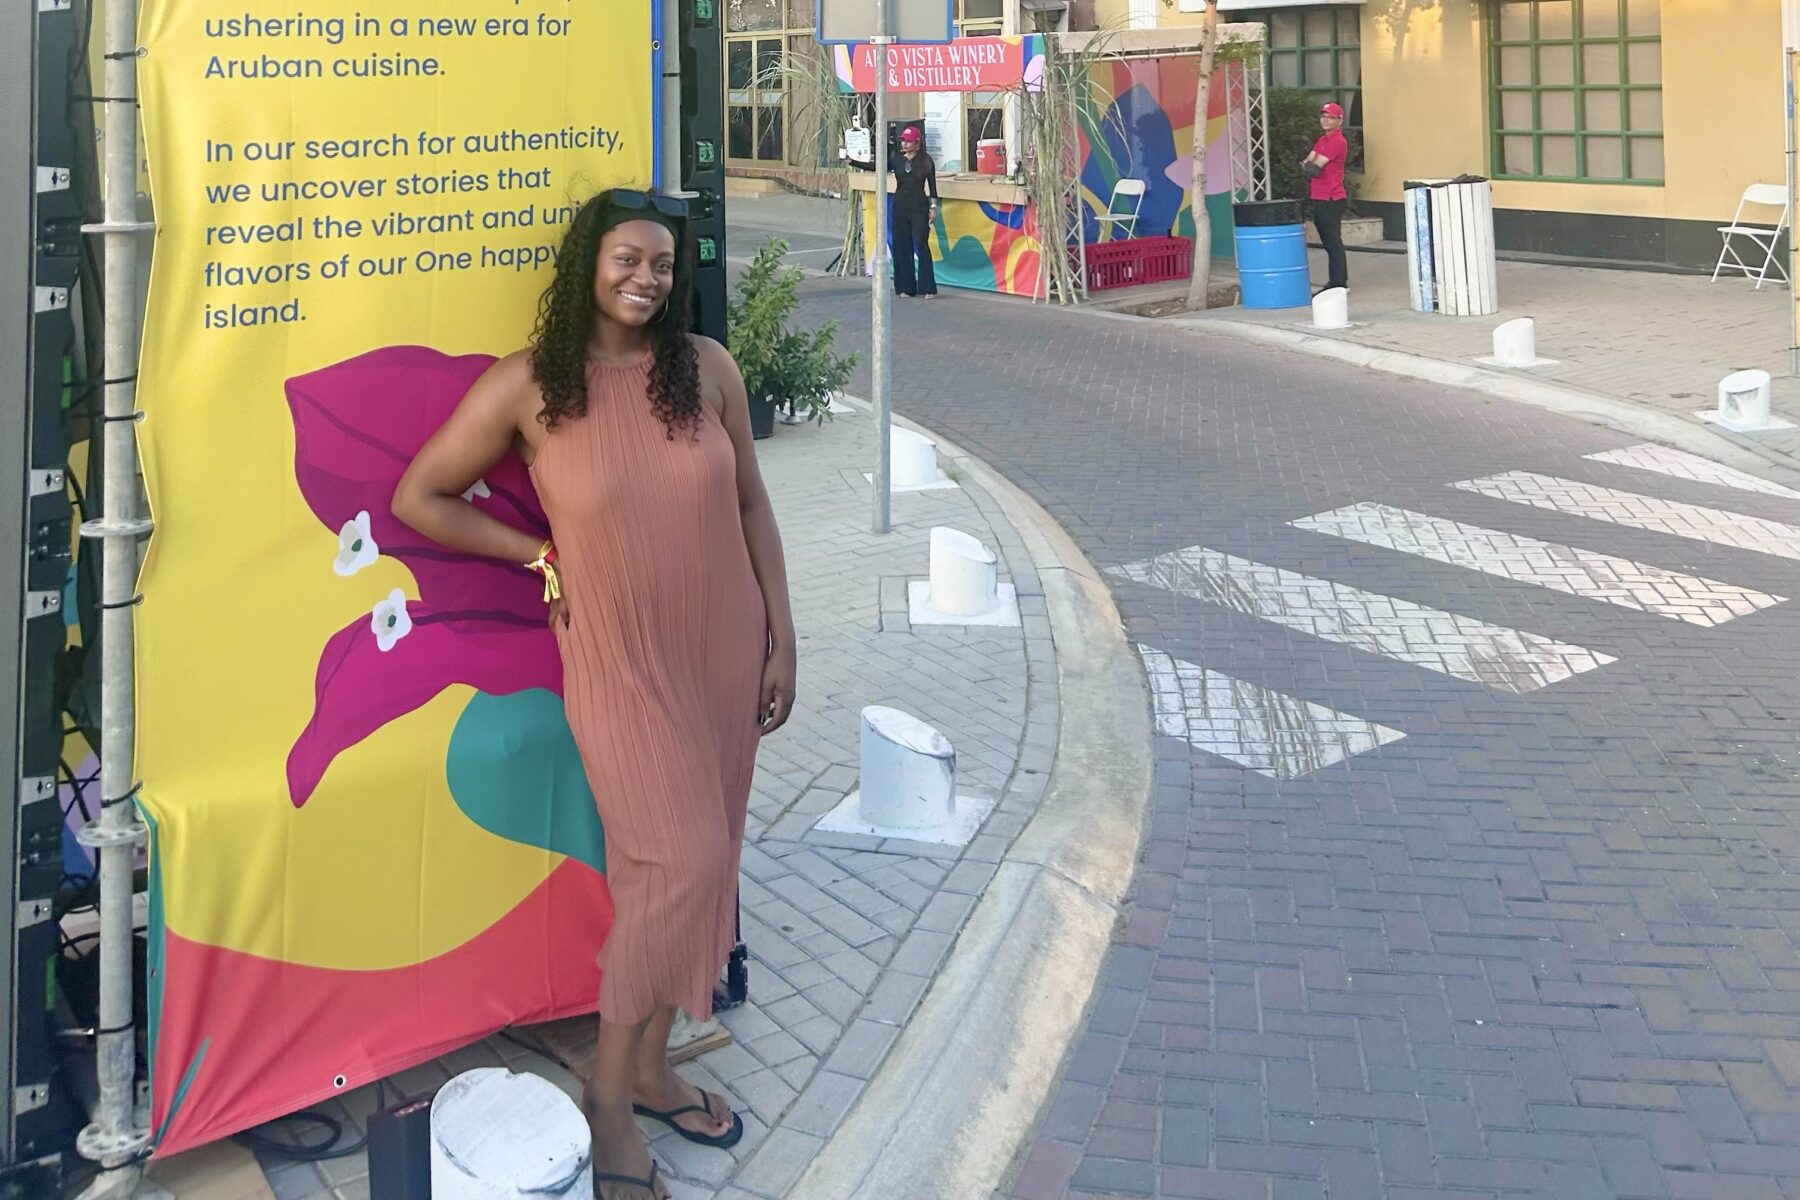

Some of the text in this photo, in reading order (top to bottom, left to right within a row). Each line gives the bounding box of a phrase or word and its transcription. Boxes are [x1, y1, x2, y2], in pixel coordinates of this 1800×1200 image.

[205, 11, 572, 45] ushering in a new era for
[204, 52, 446, 79] Aruban cuisine.
[864, 43, 1006, 68] AO VISTA WINERY
[888, 66, 982, 87] & DISTILLERY
[206, 125, 624, 163] In our search for authenticity,
[205, 166, 552, 205] we uncover stories that
[206, 216, 303, 246] reveal
[312, 215, 363, 239] the
[370, 209, 475, 237] vibrant
[481, 203, 534, 230] and
[204, 261, 311, 287] flavors
[320, 253, 350, 280] of
[358, 256, 408, 277] our
[415, 250, 473, 273] One
[205, 297, 307, 329] island.
